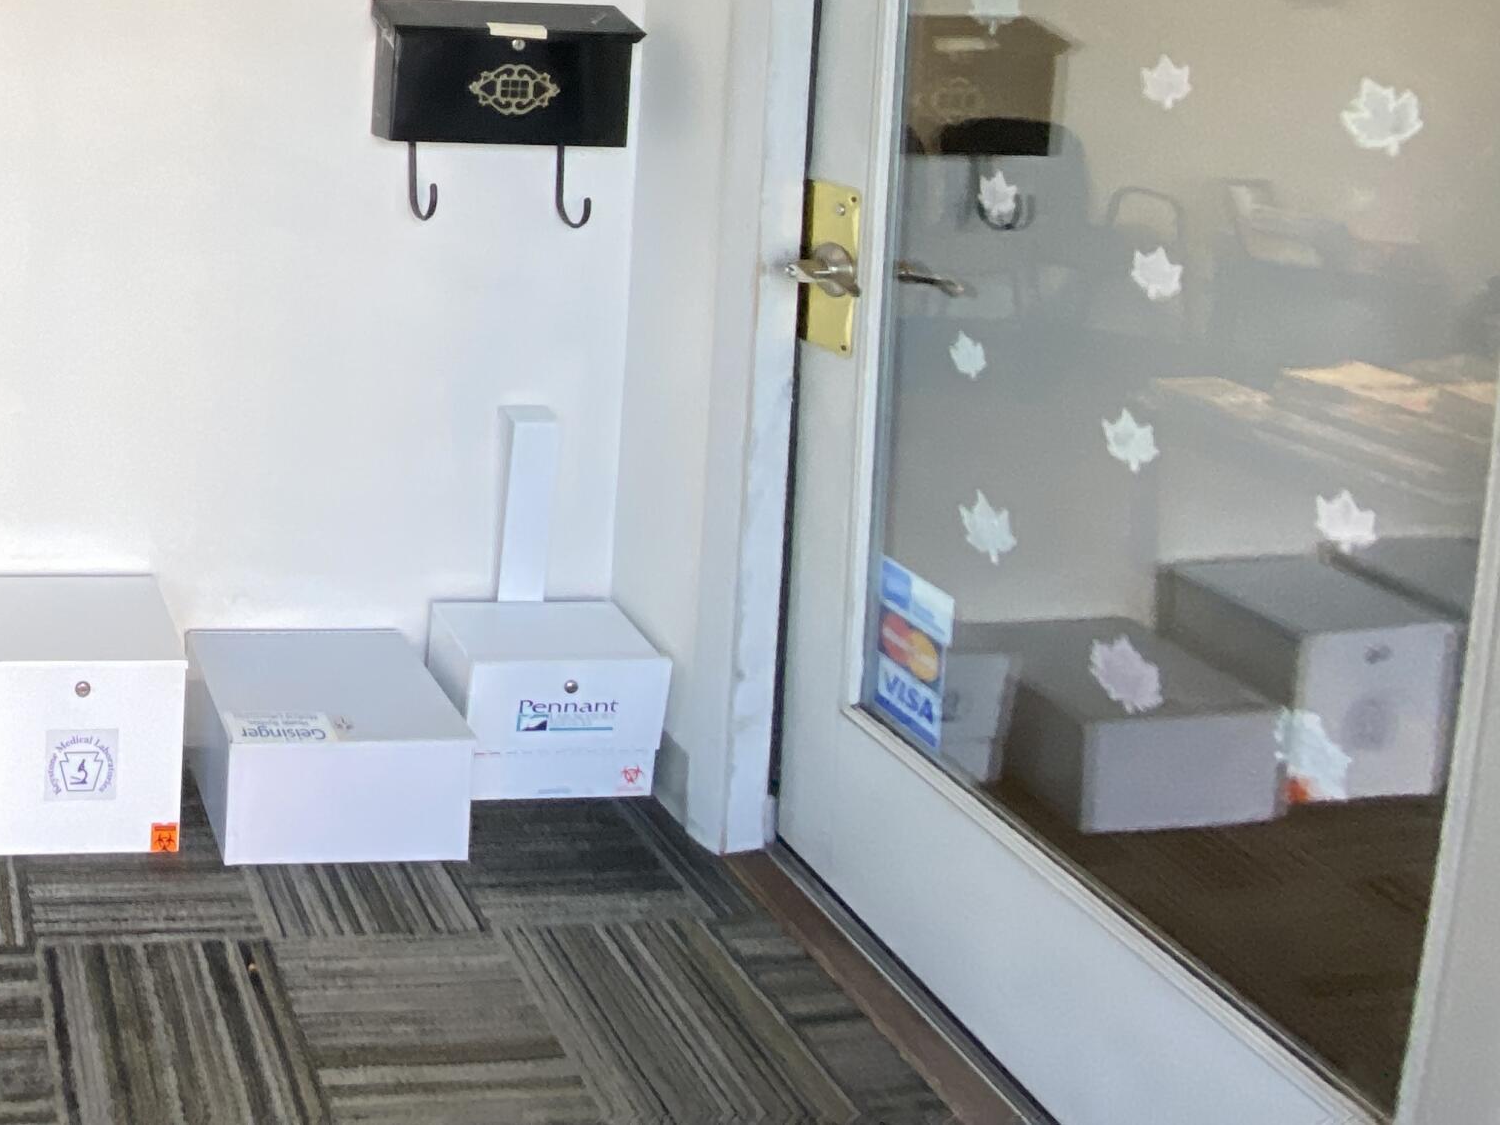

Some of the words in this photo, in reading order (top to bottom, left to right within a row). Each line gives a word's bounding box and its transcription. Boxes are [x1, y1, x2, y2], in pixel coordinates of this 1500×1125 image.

[519, 699, 619, 714] Pennant
[884, 669, 934, 725] VISA
[241, 725, 326, 740] Geisinger
[48, 752, 62, 795] Keystone
[55, 735, 94, 753] Medical
